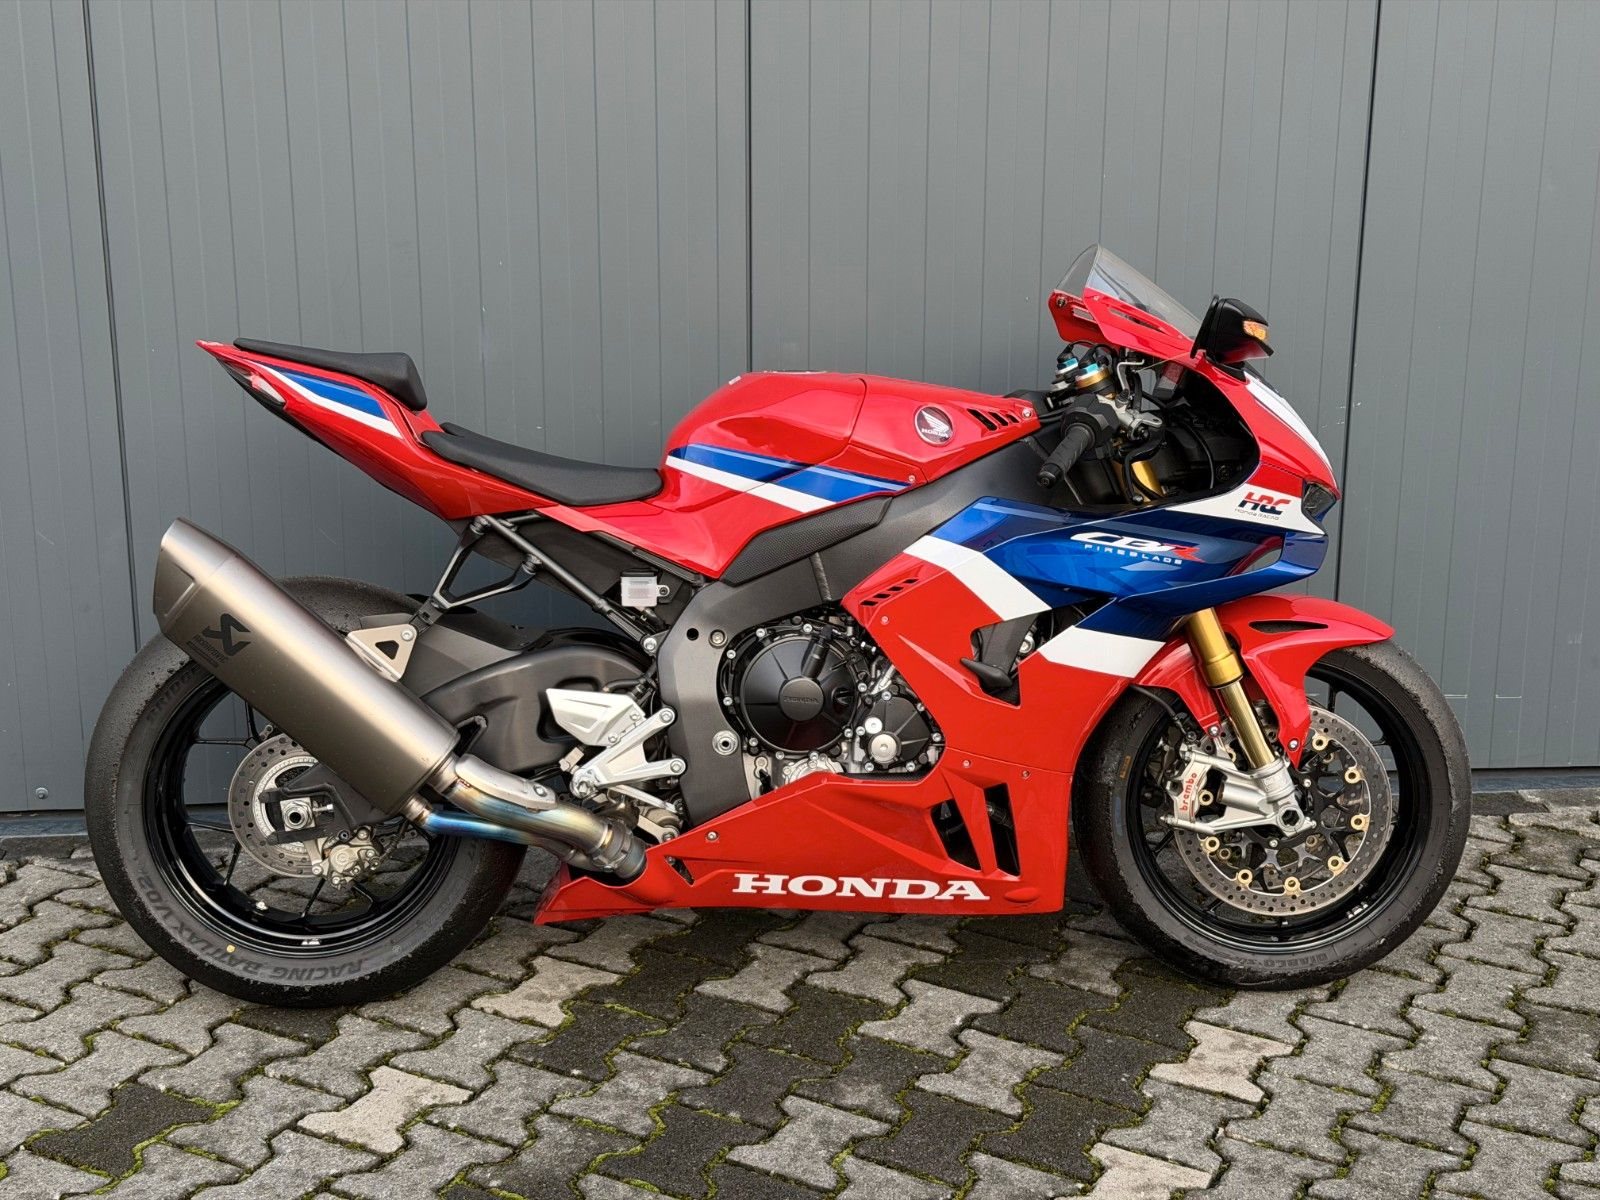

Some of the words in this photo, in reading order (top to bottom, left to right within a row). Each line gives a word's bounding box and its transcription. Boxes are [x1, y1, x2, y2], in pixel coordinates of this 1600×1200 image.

[921, 428, 949, 439] HONDA
[1238, 492, 1292, 516] HRC
[1085, 544, 1183, 565] FIREBLADE
[1180, 773, 1197, 811] brembo
[136, 873, 175, 922] V02
[732, 872, 991, 901] HONDA
[171, 919, 264, 977] BATTLAX
[270, 958, 365, 981] RACING
